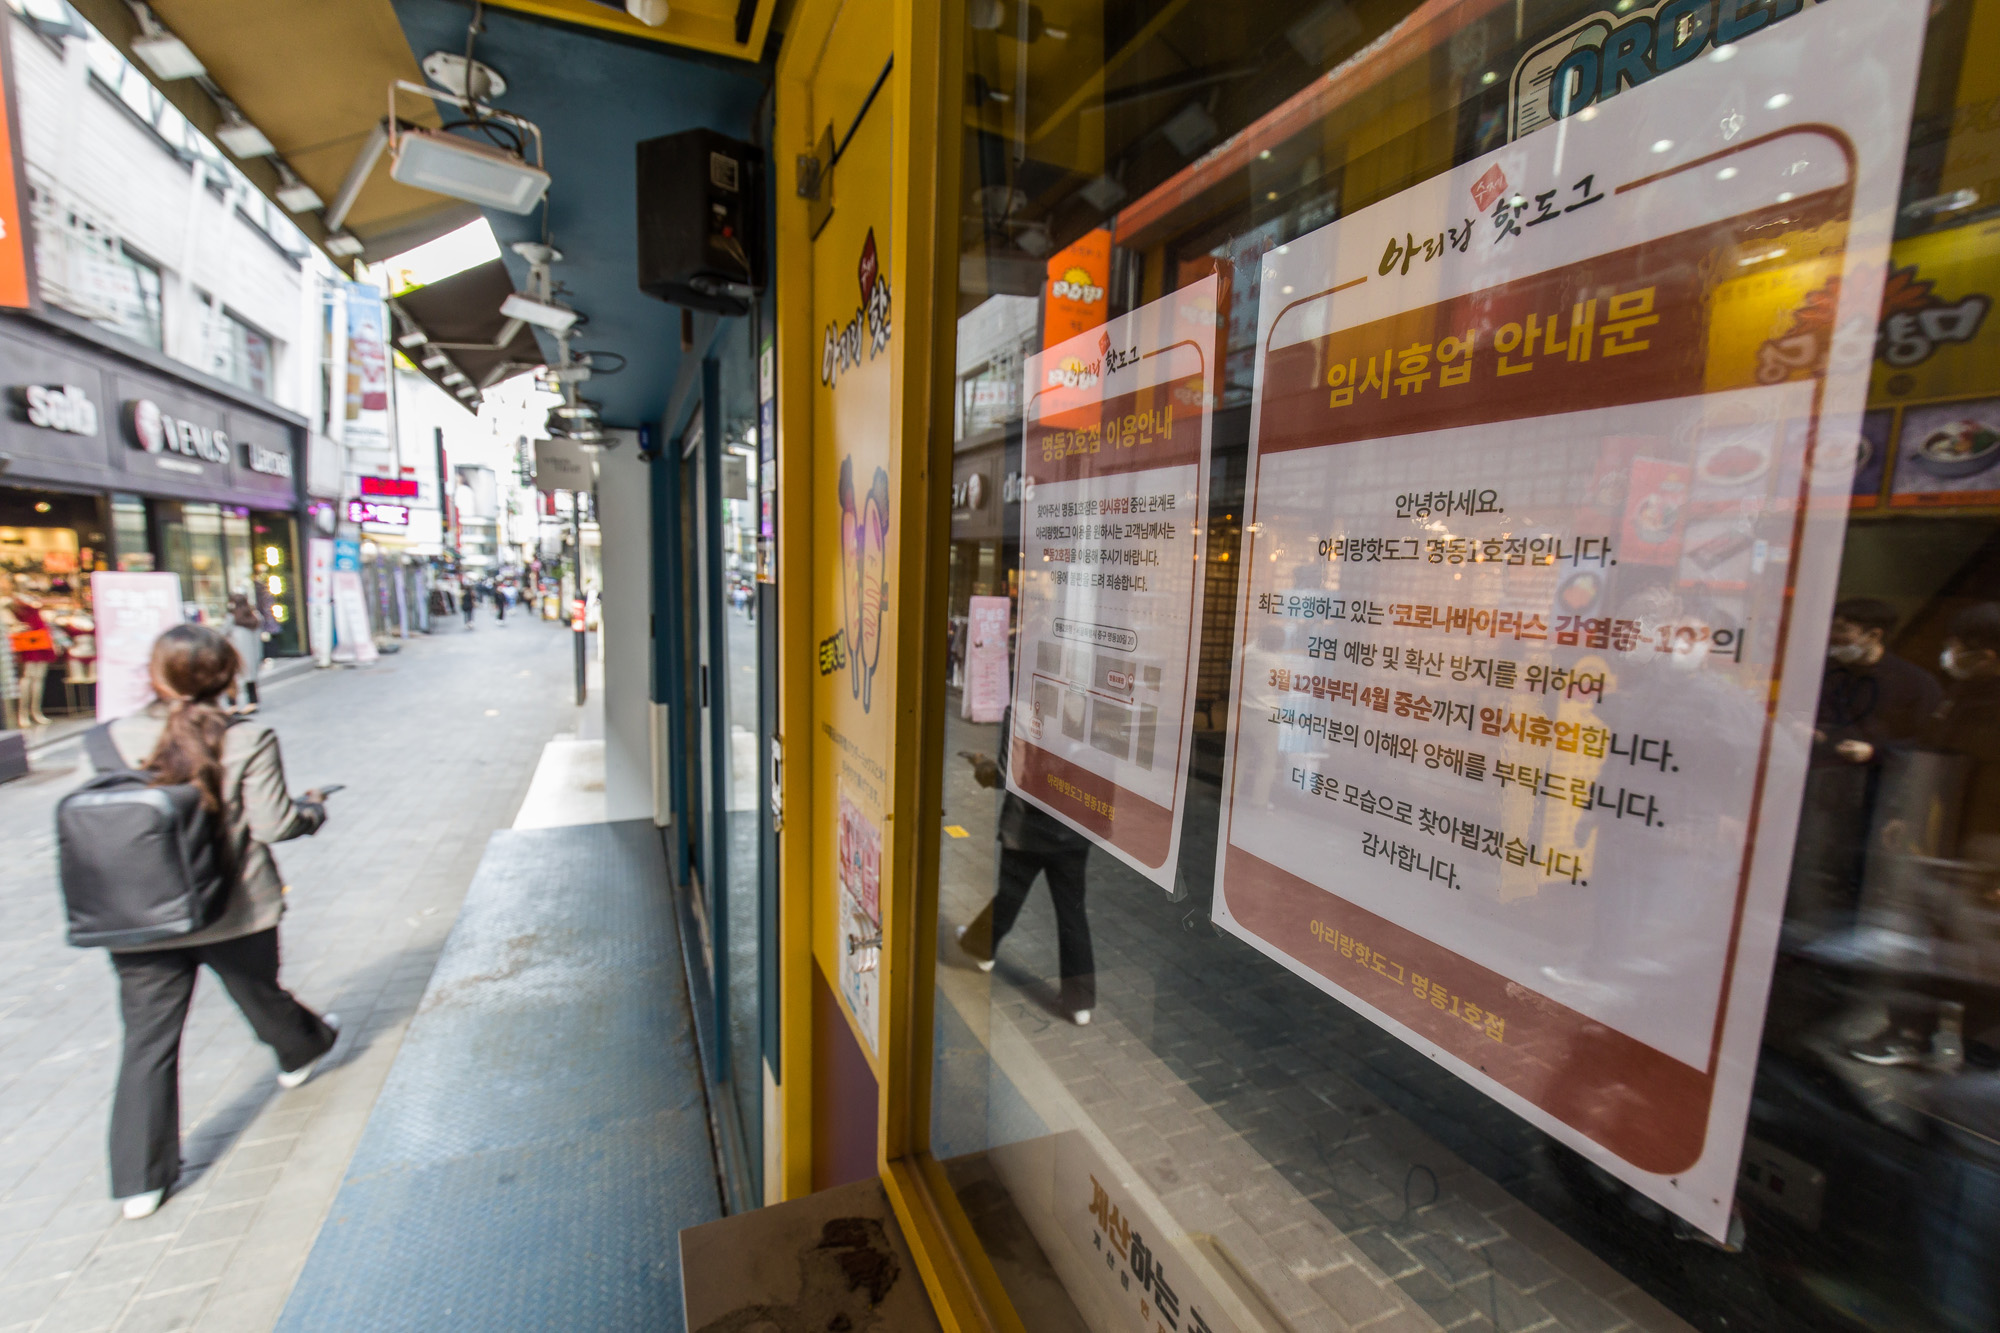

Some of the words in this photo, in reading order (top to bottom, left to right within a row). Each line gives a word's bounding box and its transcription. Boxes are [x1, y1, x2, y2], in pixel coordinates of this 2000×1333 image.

[1378, 218, 1476, 276] 아리랑
[1491, 174, 1604, 245] 핫도그
[868, 274, 892, 361] 핫
[1106, 345, 1140, 376] 핫도그
[1327, 329, 1475, 408] 임시휴업
[1494, 286, 1660, 377] 안내문
[160, 414, 230, 464] VENUS
[1042, 422, 1101, 462] 명동2호점
[1106, 404, 1173, 450] 이용안내
[1037, 502, 1061, 519] 찾아주신
[1061, 500, 1098, 518] 명동1호점은
[1099, 497, 1129, 515] 임시휴업
[1130, 495, 1147, 514] 중인
[1148, 494, 1176, 512] 관계로
[1395, 488, 1504, 518] 안녕하세요.
[1036, 524, 1071, 541] 아리랑핫도그
[1072, 524, 1092, 540] 이용을
[1093, 523, 1123, 541] 원하시는
[1124, 522, 1176, 540] 고객님께서는
[1078, 549, 1099, 564] 이용해
[1100, 549, 1123, 565] 주시기
[1123, 549, 1159, 567] 바랍니다.
[1318, 538, 1419, 562] 아리랑핫도그
[1426, 536, 1617, 568] 명동1호점입니다.
[1051, 570, 1068, 586] 이용에
[1091, 573, 1105, 590] 드려
[1106, 574, 1148, 593] 죄송합니다.
[1258, 592, 1284, 615] 최근
[1287, 595, 1346, 620] 유행하고
[1350, 600, 1385, 625] 있는
[1307, 636, 1338, 661] 감염
[1344, 641, 1378, 667] 예방
[1382, 646, 1399, 672] 및
[1404, 648, 1445, 678] 확산
[1450, 655, 1518, 690] 방지를
[1524, 664, 1605, 704] 위하여
[1268, 668, 1291, 692] 3월
[1293, 673, 1358, 707] 12일부터
[1360, 686, 1390, 714] 4월
[1394, 690, 1475, 731] 중순까지
[1480, 707, 1679, 773] 임시휴업합니다.
[1267, 706, 1295, 730] 고객
[1298, 712, 1359, 748] 여러분의
[1364, 729, 1418, 764] 이해와
[1423, 743, 1487, 783] 양해를
[1492, 760, 1664, 828] 부탁드립니다.
[1047, 773, 1083, 802] 아리랑핫도그
[1084, 792, 1116, 822] 명동1호점
[1292, 767, 1306, 791] 더
[1310, 771, 1340, 802] 좋은
[1342, 783, 1413, 826] 모습으로
[1418, 807, 1588, 887] 찾아뵙겠습니다.
[1361, 831, 1461, 891] 감사합니다.
[1310, 919, 1406, 987] 아리랑핫도그
[1411, 972, 1506, 1043] 명동1호점
